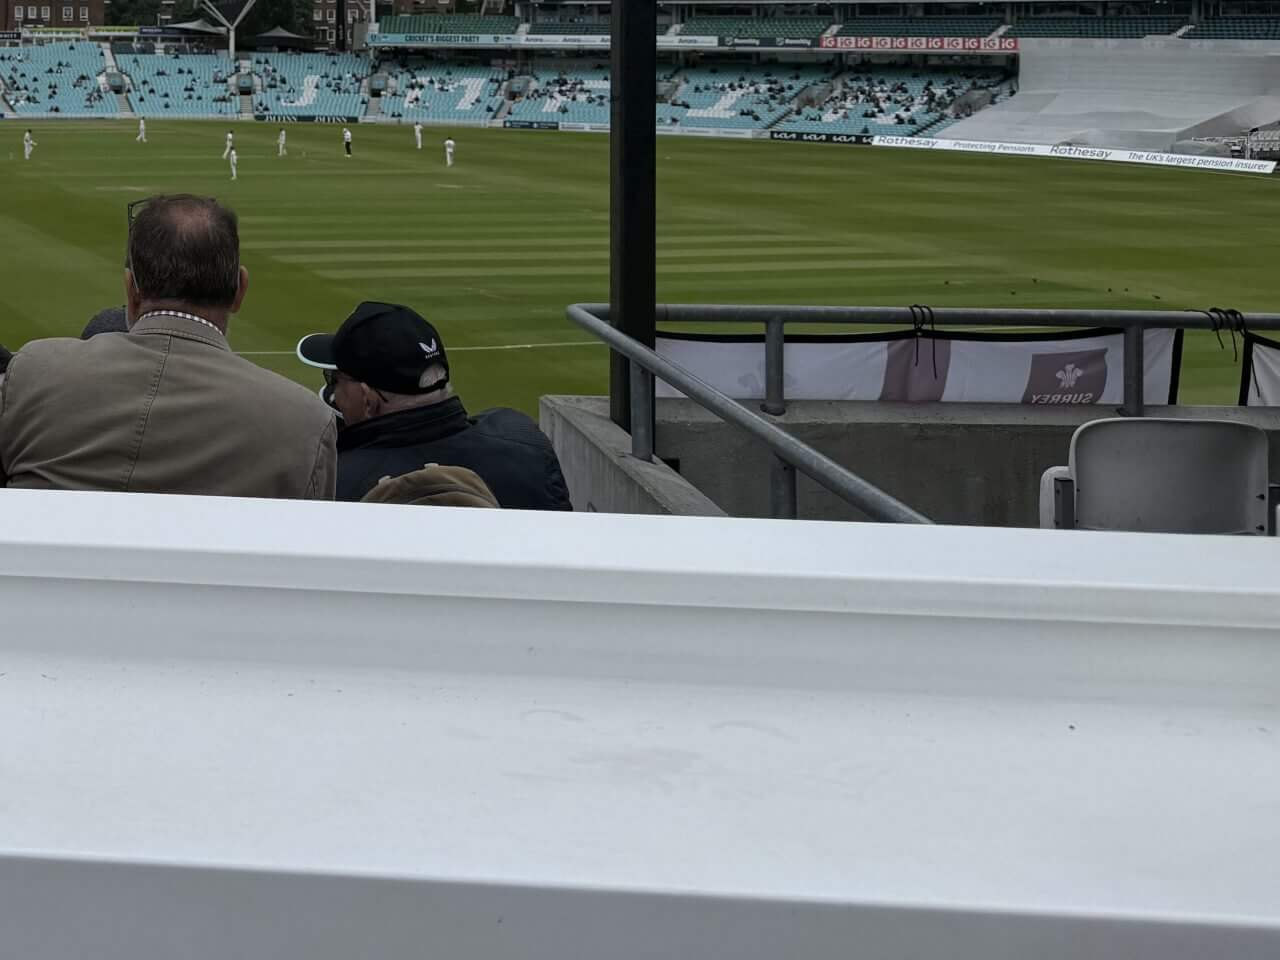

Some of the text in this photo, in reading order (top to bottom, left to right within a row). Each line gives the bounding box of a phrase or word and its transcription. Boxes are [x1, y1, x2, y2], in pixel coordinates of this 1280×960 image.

[877, 135, 938, 148] Rothesay
[952, 141, 996, 152] Protecting
[997, 143, 1035, 153] Pensions
[1050, 145, 1270, 171] Rothesay The UK's largest pension insurer
